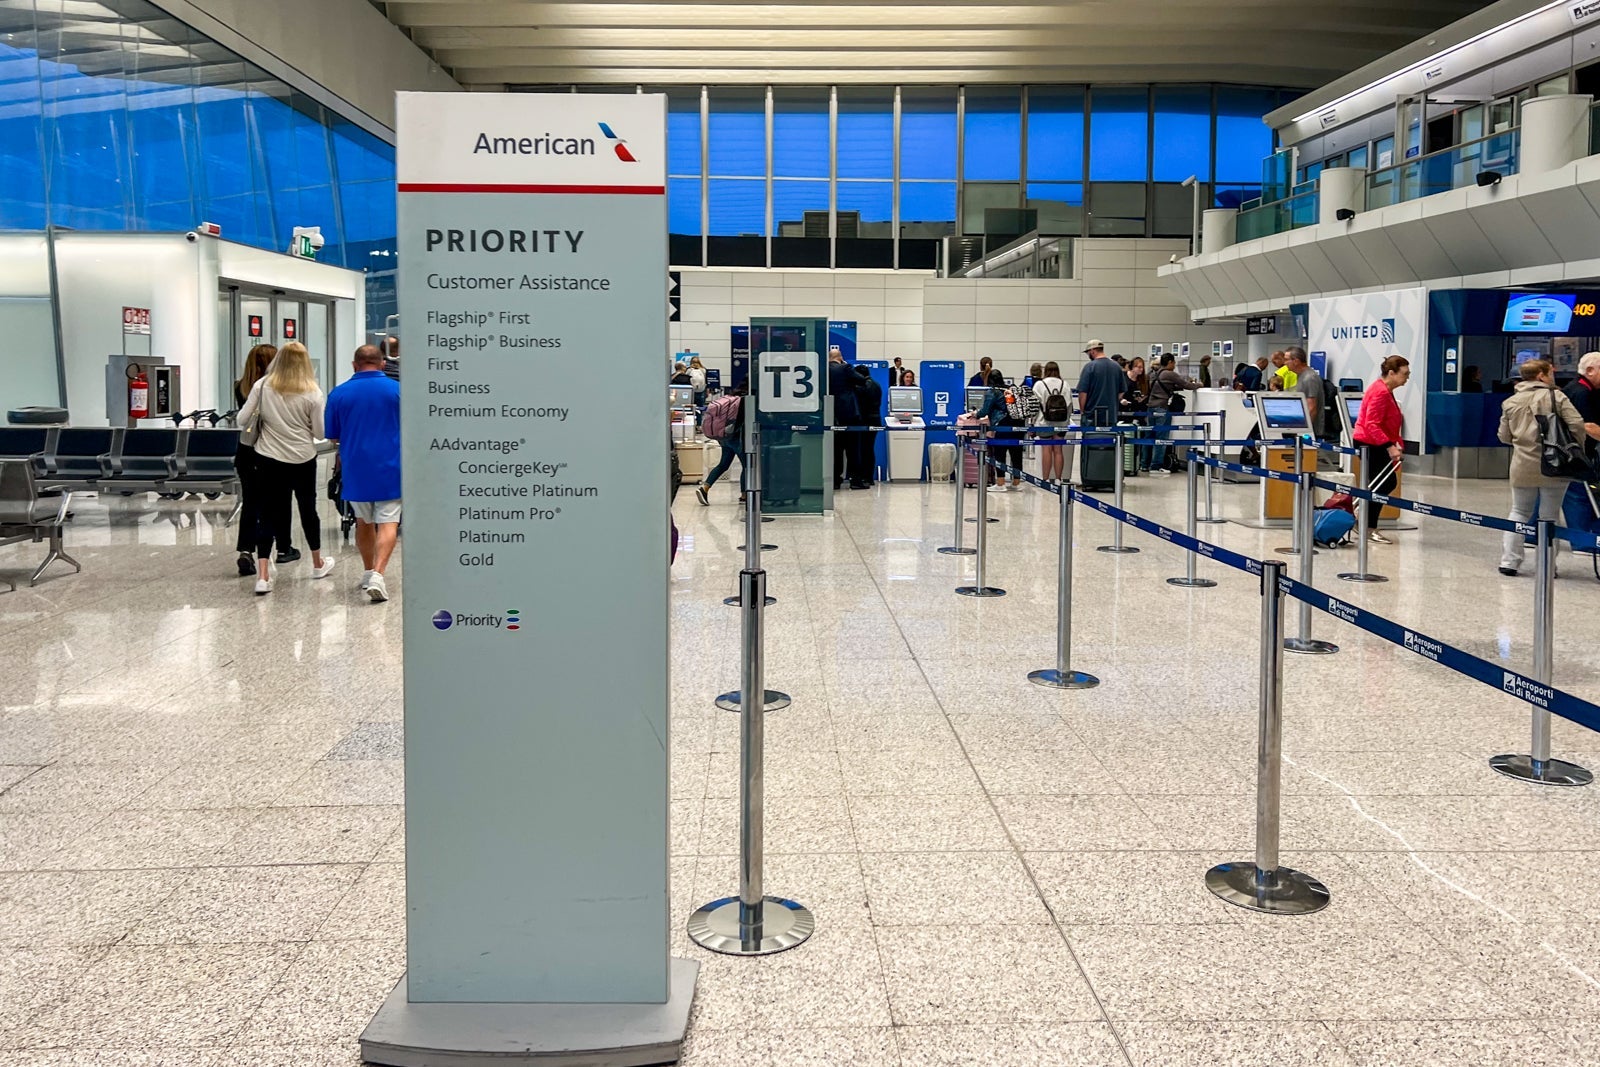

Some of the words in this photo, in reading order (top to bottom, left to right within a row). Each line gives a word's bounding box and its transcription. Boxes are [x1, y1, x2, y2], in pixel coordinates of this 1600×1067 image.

[473, 133, 595, 155] American
[426, 229, 584, 253] PRIORITY
[427, 274, 514, 290] Customer
[519, 275, 610, 290] Assistance
[1573, 303, 1596, 316] 409
[499, 311, 530, 324] First
[1332, 325, 1378, 339] UNITED
[500, 335, 561, 348] Business
[428, 358, 459, 371] First
[429, 381, 490, 394] Business
[764, 365, 813, 398] T3
[429, 404, 496, 417] Premium
[501, 405, 569, 421] Economy
[459, 484, 528, 497] Executive
[533, 484, 598, 497] Platinum
[459, 507, 525, 520] Platinum
[459, 530, 525, 543] Platinum
[459, 553, 494, 566] Gold
[1336, 601, 1359, 616] Aeroporti
[456, 614, 502, 629] Priority
[1341, 610, 1355, 622] Roma
[1413, 635, 1442, 654] Aeroporti
[1414, 645, 1420, 653] di
[1420, 646, 1438, 660] Roma
[1516, 676, 1554, 699] Aeroporti
[1516, 688, 1524, 697] di
[1525, 691, 1548, 707] Roma
